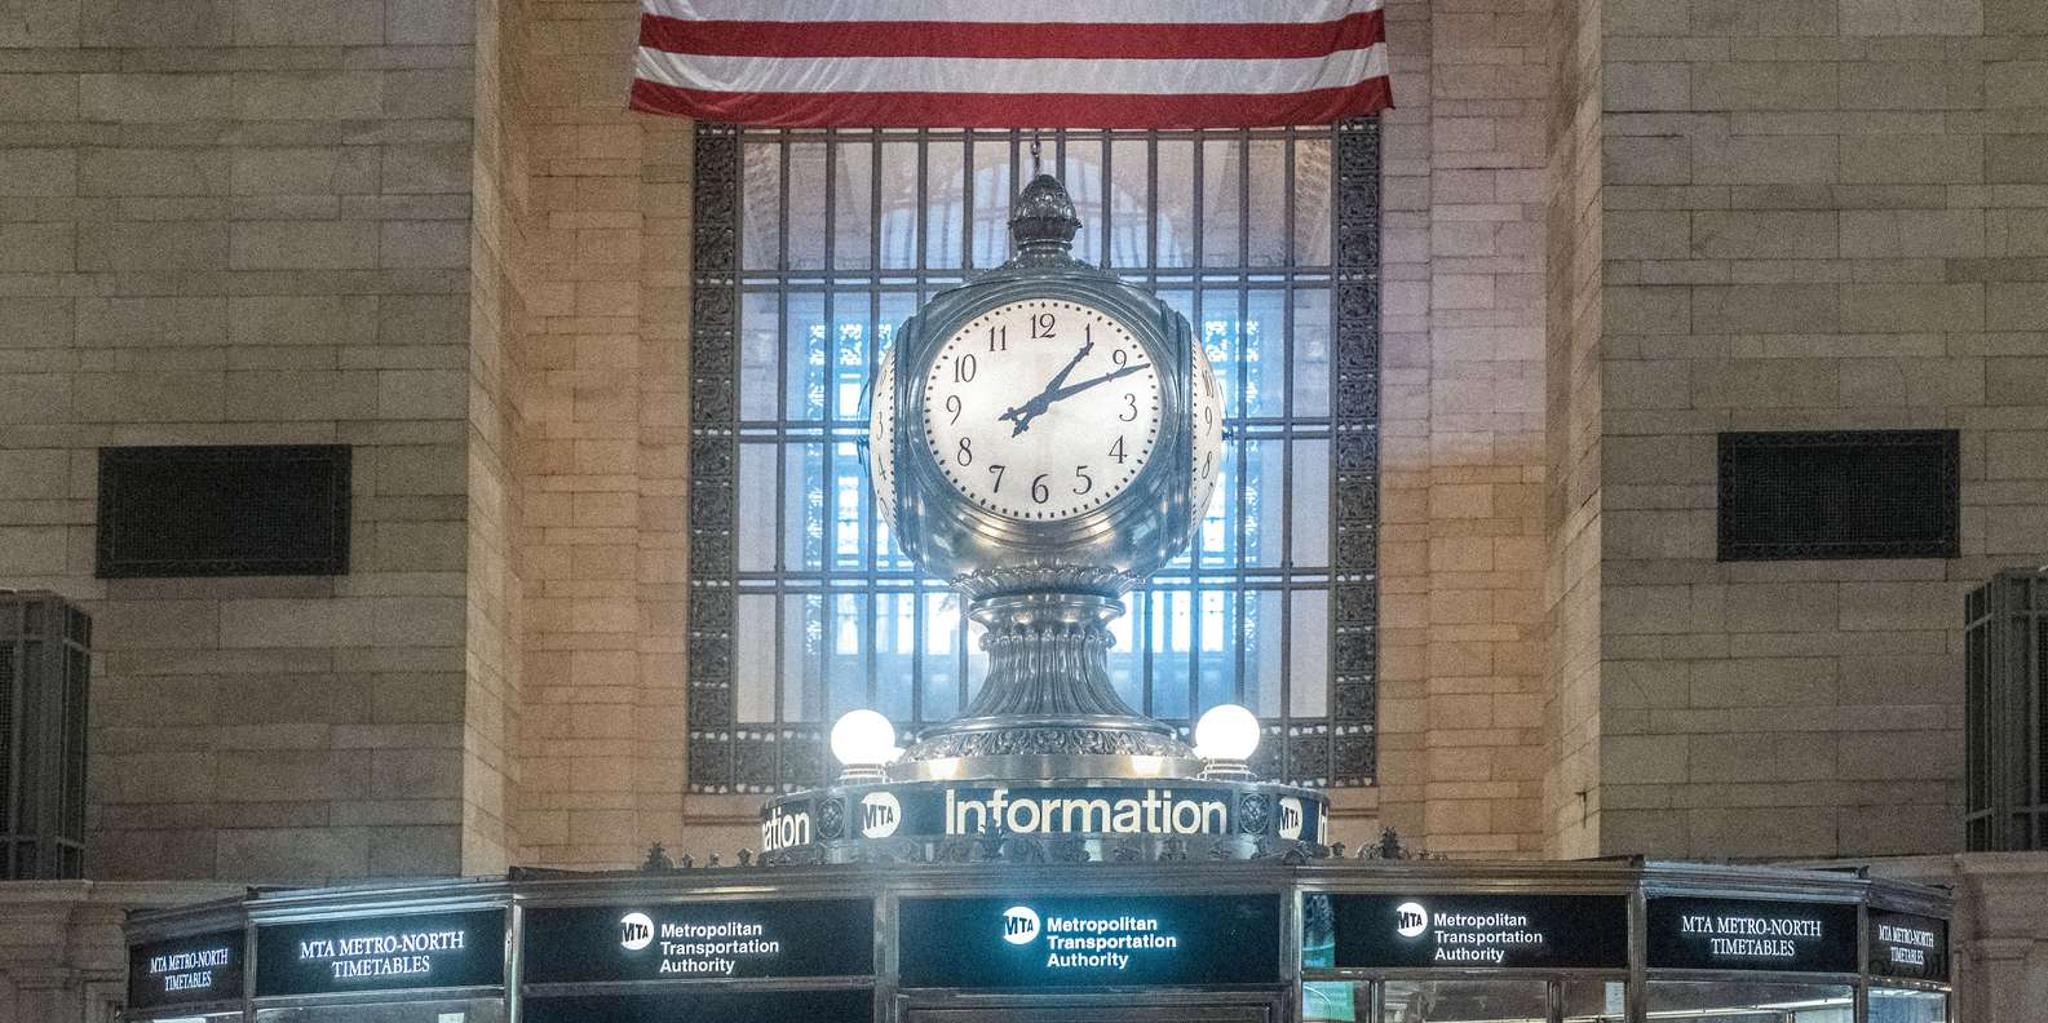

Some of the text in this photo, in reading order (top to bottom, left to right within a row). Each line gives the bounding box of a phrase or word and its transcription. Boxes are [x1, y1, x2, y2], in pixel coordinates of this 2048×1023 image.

[1029, 313, 1056, 339] 12
[988, 325, 1007, 352] 11
[954, 353, 977, 383] 10
[946, 394, 962, 426] 9
[1118, 393, 1138, 422] 3
[957, 436, 973, 467] 8
[1108, 434, 1128, 464] 4
[988, 464, 1006, 493] 7
[1031, 473, 1050, 504] 6
[1072, 464, 1093, 495] 5
[945, 788, 1228, 835] Information
[661, 921, 762, 940] Metropolitan
[1047, 916, 1158, 935] Metropolitan
[1433, 912, 1527, 929] Metropolitan
[1682, 915, 1822, 937] MTA METRO-NORTH
[300, 931, 465, 959] MTA METRO-NORTH
[660, 939, 779, 957] Transportation
[1047, 933, 1177, 952] Transportation
[1434, 930, 1543, 946] Transportation
[1711, 938, 1796, 957] TIMETABLES
[149, 948, 229, 974] MTA METRO-NORTH
[331, 955, 431, 978] TIMETABLES
[659, 957, 735, 975] Authority
[1047, 952, 1129, 970] Authority
[1434, 947, 1505, 963] Authority
[164, 970, 212, 991] TIMETABLES
